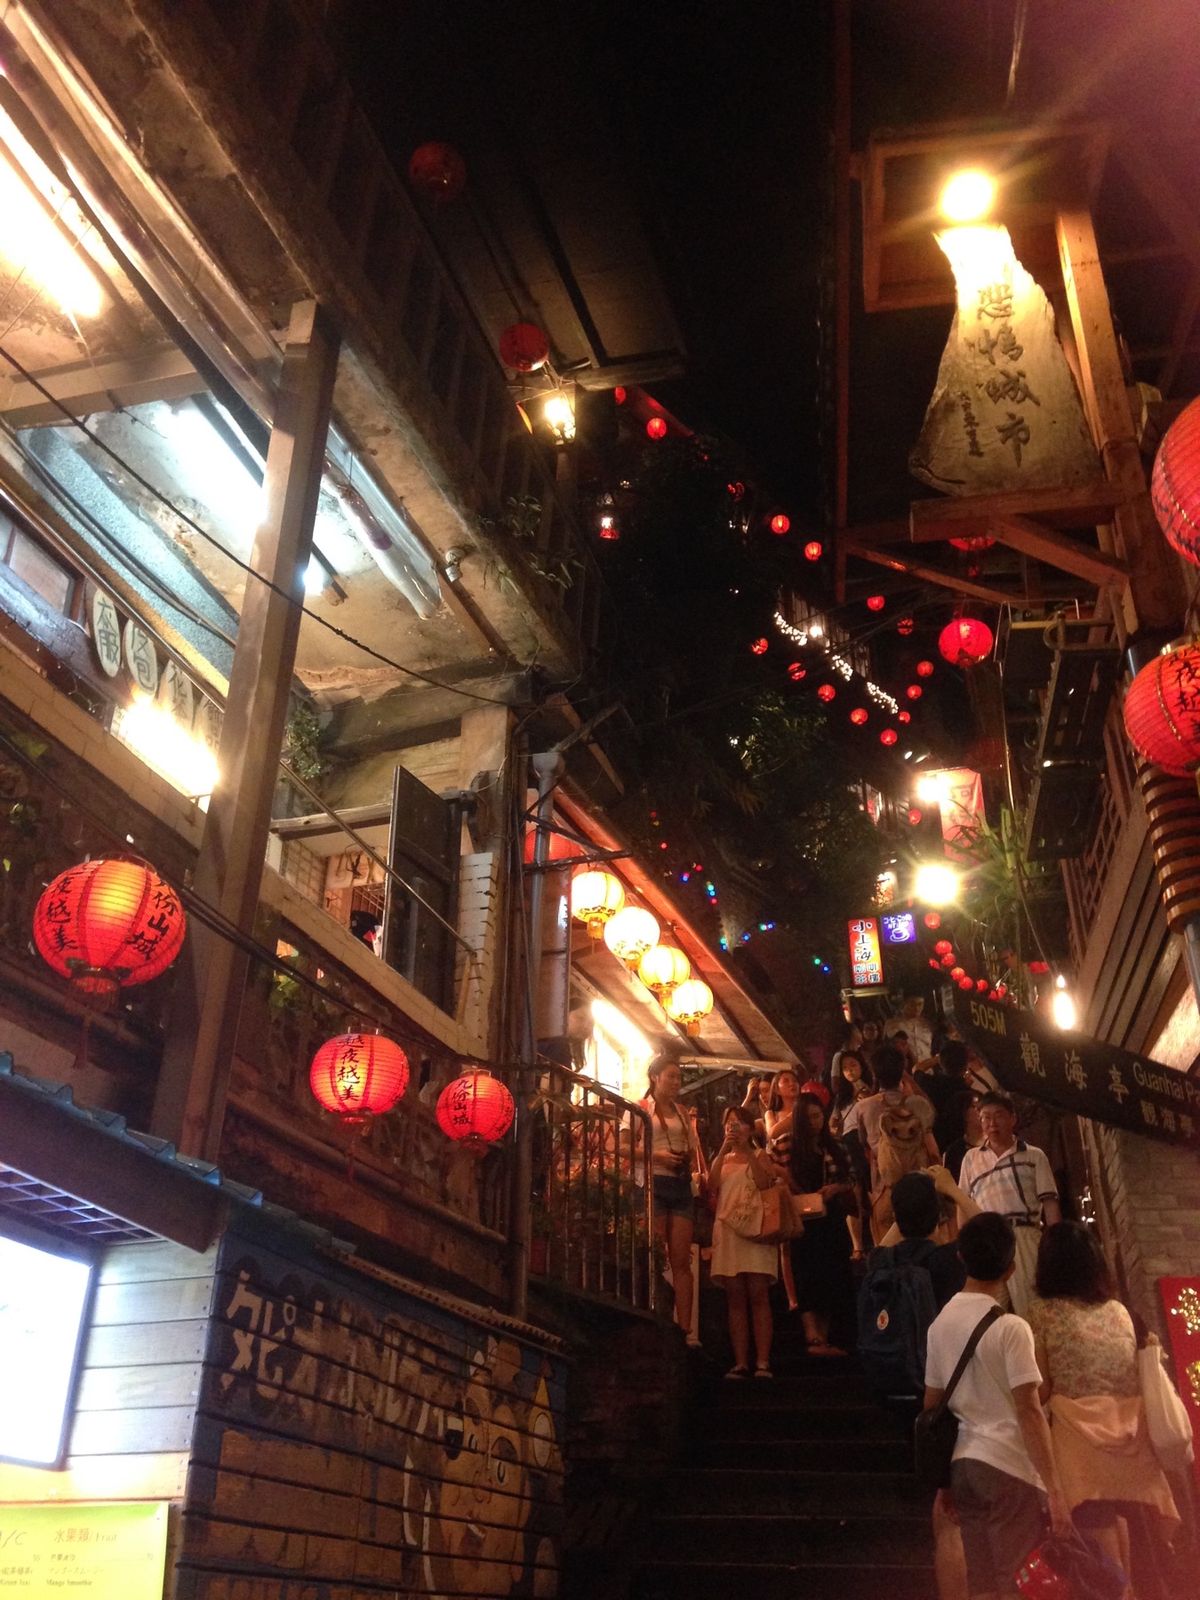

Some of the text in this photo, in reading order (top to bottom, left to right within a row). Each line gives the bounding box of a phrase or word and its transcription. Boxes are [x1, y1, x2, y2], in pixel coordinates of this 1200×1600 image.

[974, 282, 1041, 468] 悲情城市
[970, 1001, 1007, 1035] 505M
[337, 1034, 364, 1101] 越夜越美
[1133, 1061, 1185, 1101] Guanhai
[452, 1078, 473, 1125] 九份山城
